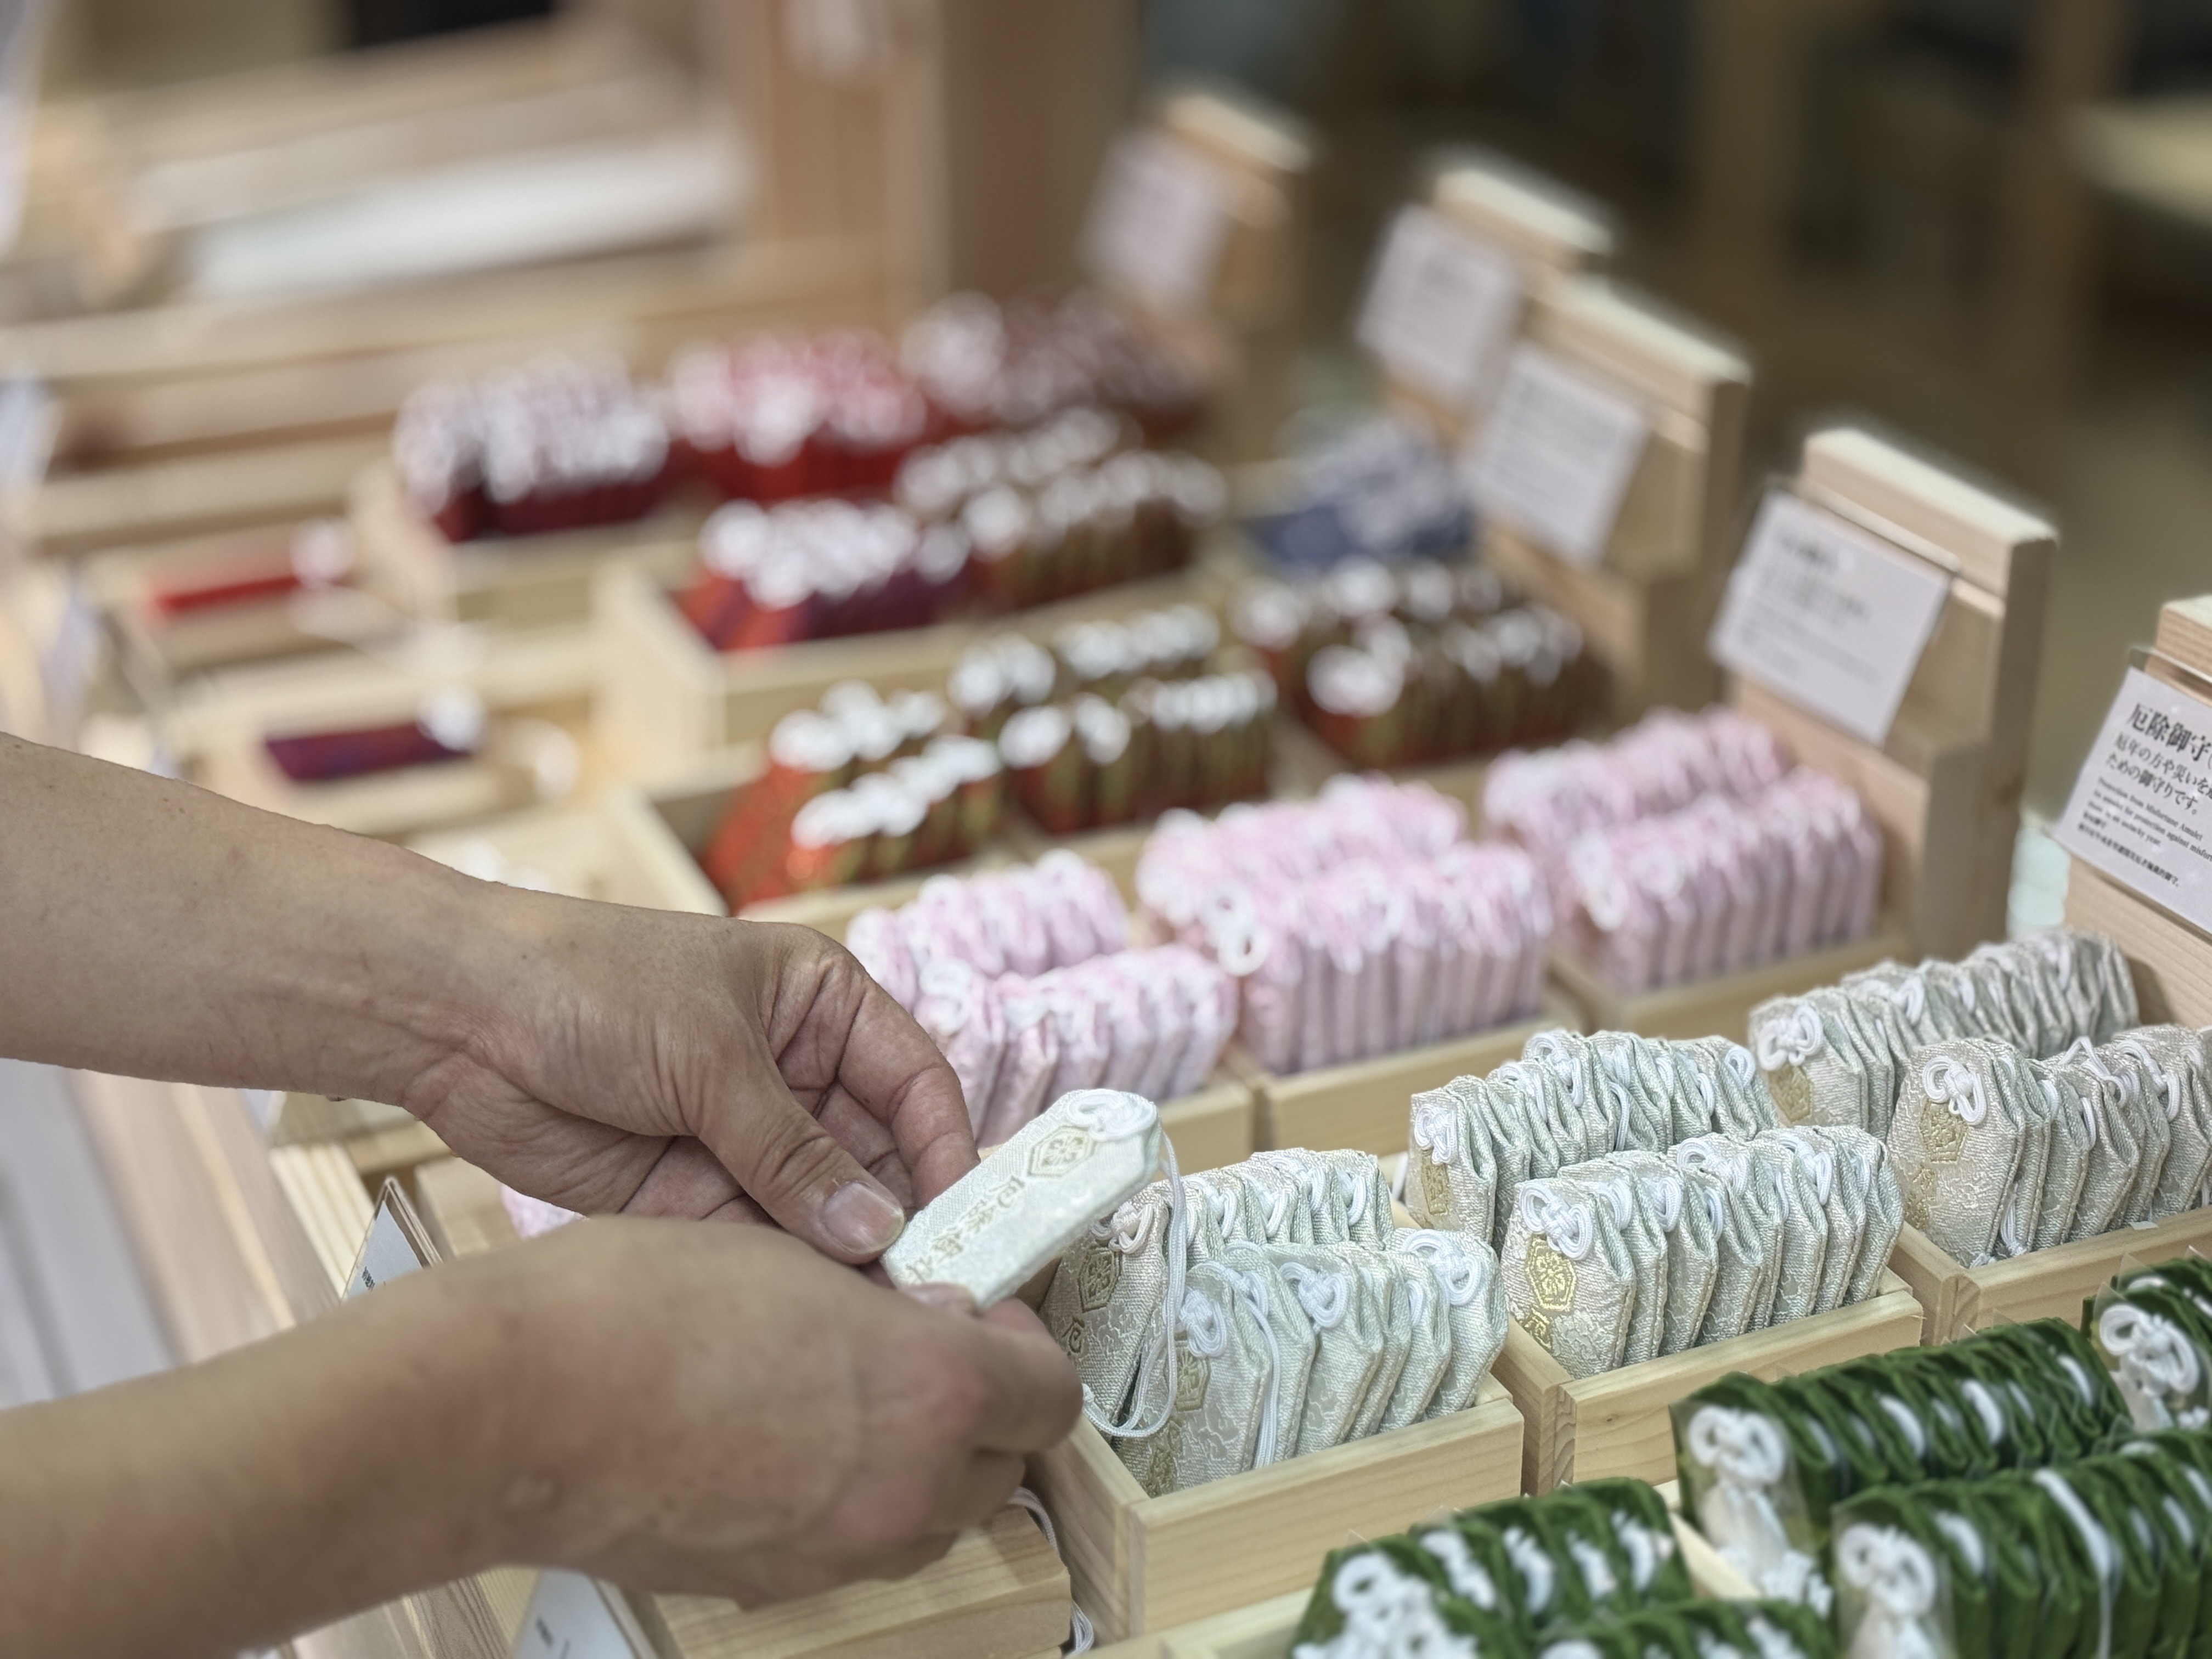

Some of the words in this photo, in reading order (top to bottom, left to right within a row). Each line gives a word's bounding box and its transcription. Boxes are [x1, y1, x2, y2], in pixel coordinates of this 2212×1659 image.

[2106, 753, 2197, 815] ための御守りです。
[2146, 803, 2179, 827] Misfortune
[2179, 823, 2203, 842] Amulet
[2166, 831, 2190, 848] against
